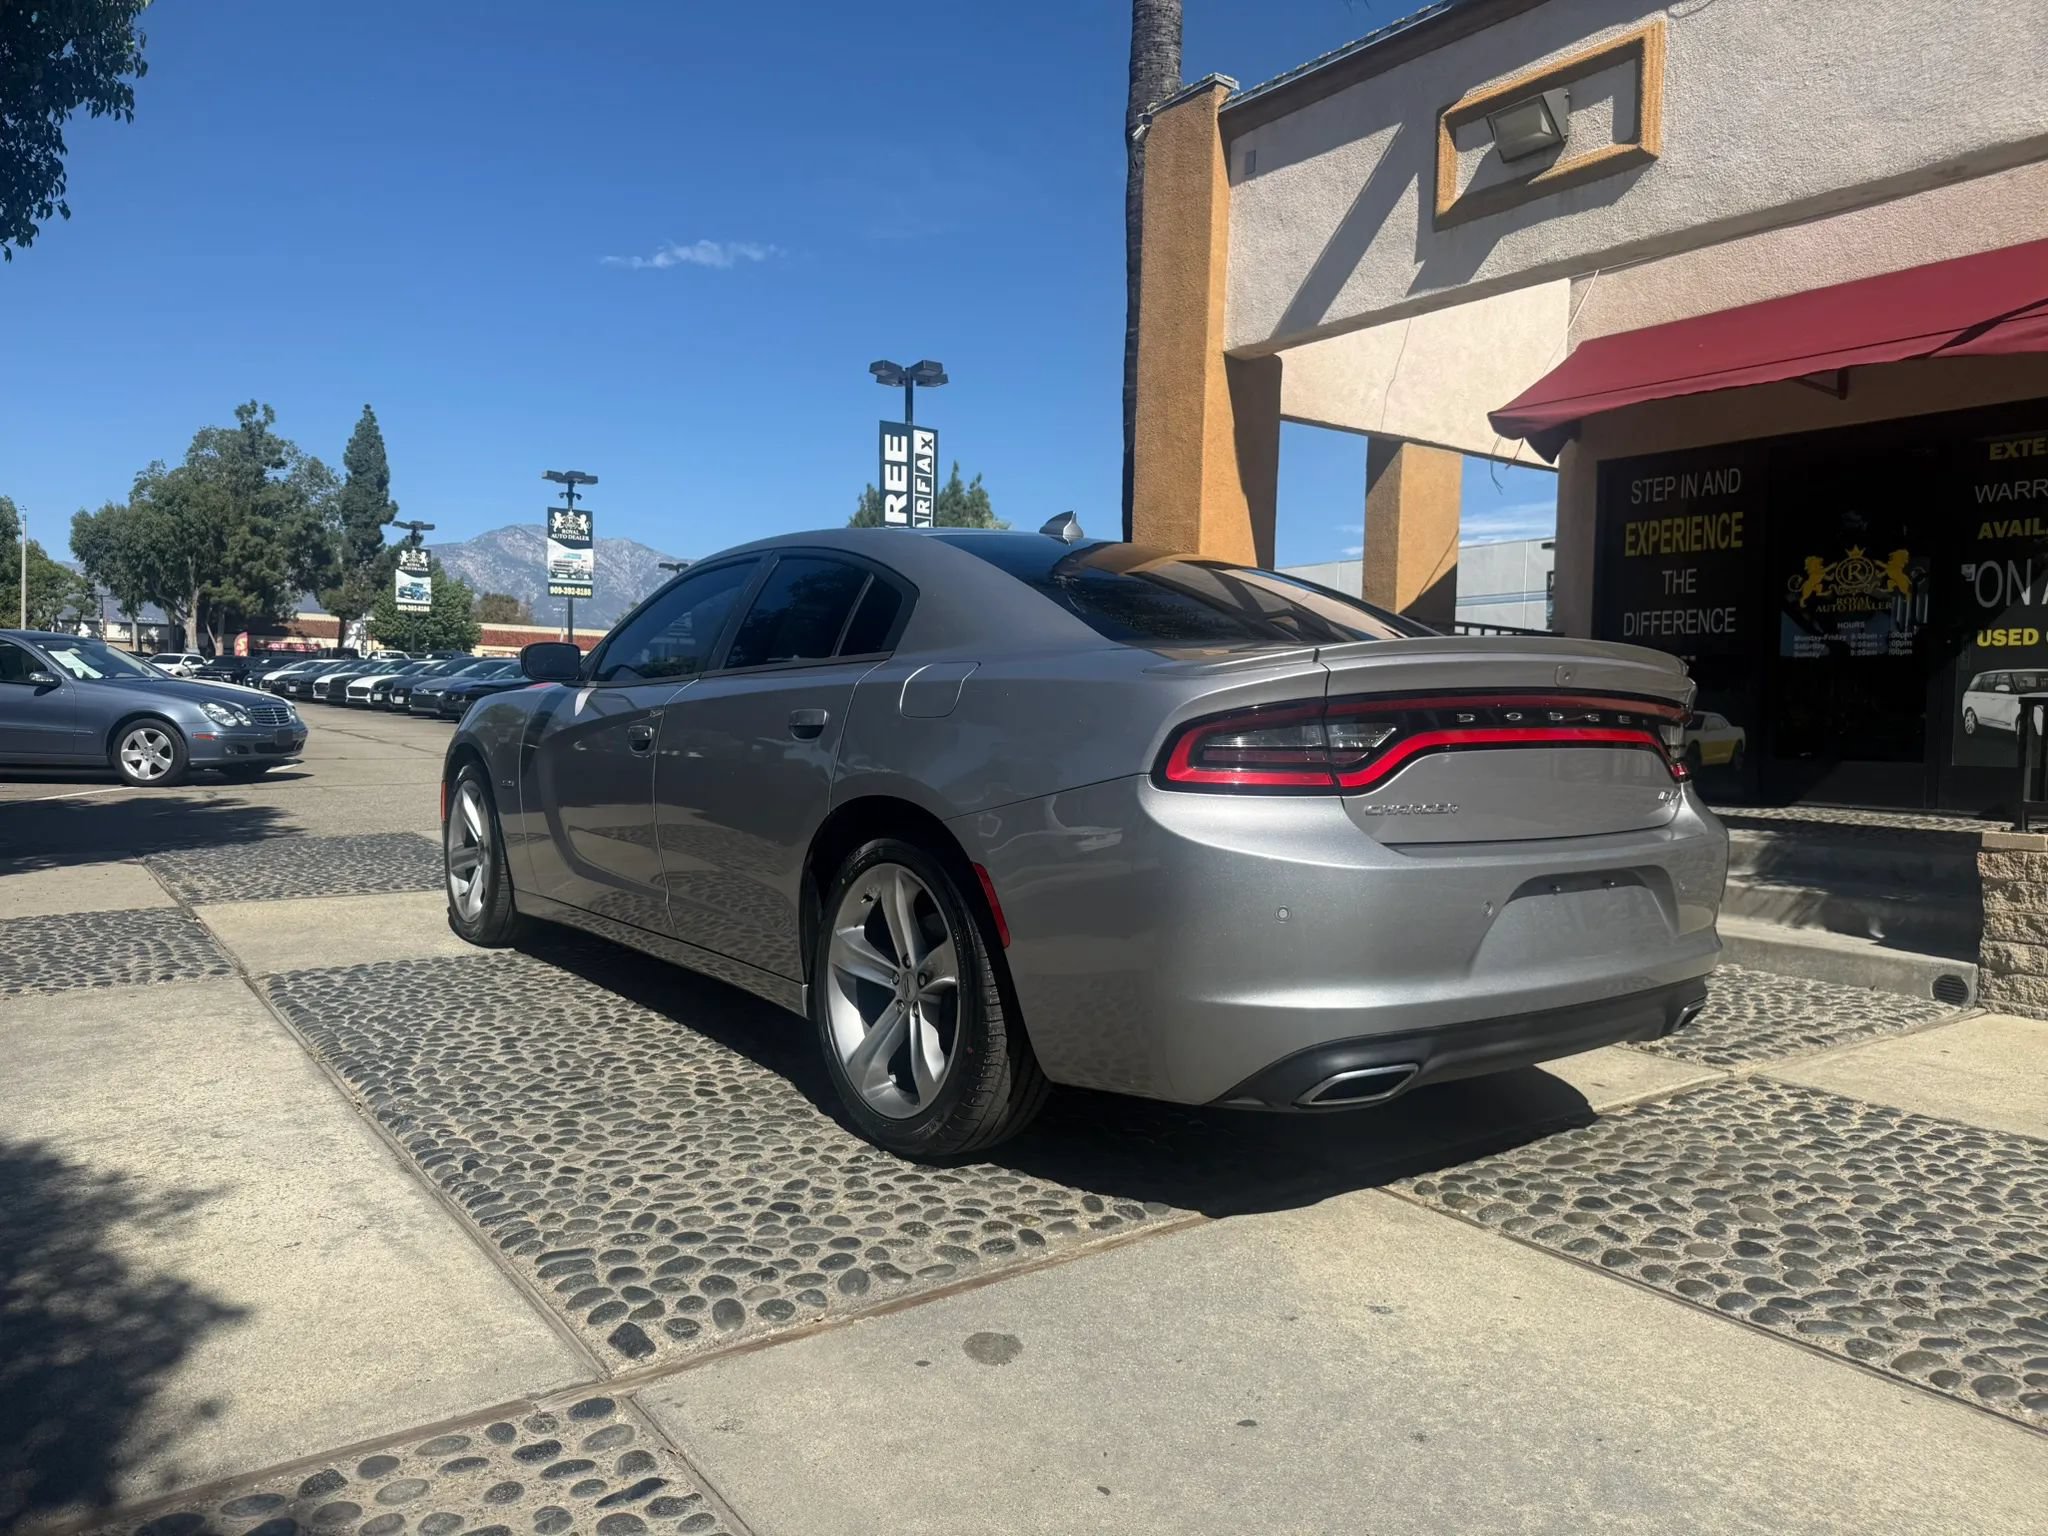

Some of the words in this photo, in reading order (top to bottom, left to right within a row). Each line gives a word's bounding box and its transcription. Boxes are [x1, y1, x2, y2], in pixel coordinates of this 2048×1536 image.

[1988, 437, 2048, 461] EXTE
[885, 434, 908, 528] REE
[1631, 475, 1677, 505] STEP
[1680, 471, 1699, 499] IN
[1701, 467, 1742, 497] AND
[1973, 478, 2048, 504] WARR
[1624, 511, 1745, 557] EXPERIENCE
[1976, 517, 2048, 541] AVAIL
[1661, 567, 1698, 595] THE
[1815, 602, 1848, 613] AUTO
[1848, 600, 1893, 611] DEALER
[1622, 606, 1737, 637] DIFFERENCE
[1836, 621, 1865, 629] HOURS
[1976, 627, 2040, 647] USED
[1456, 711, 1633, 725] DODGE
